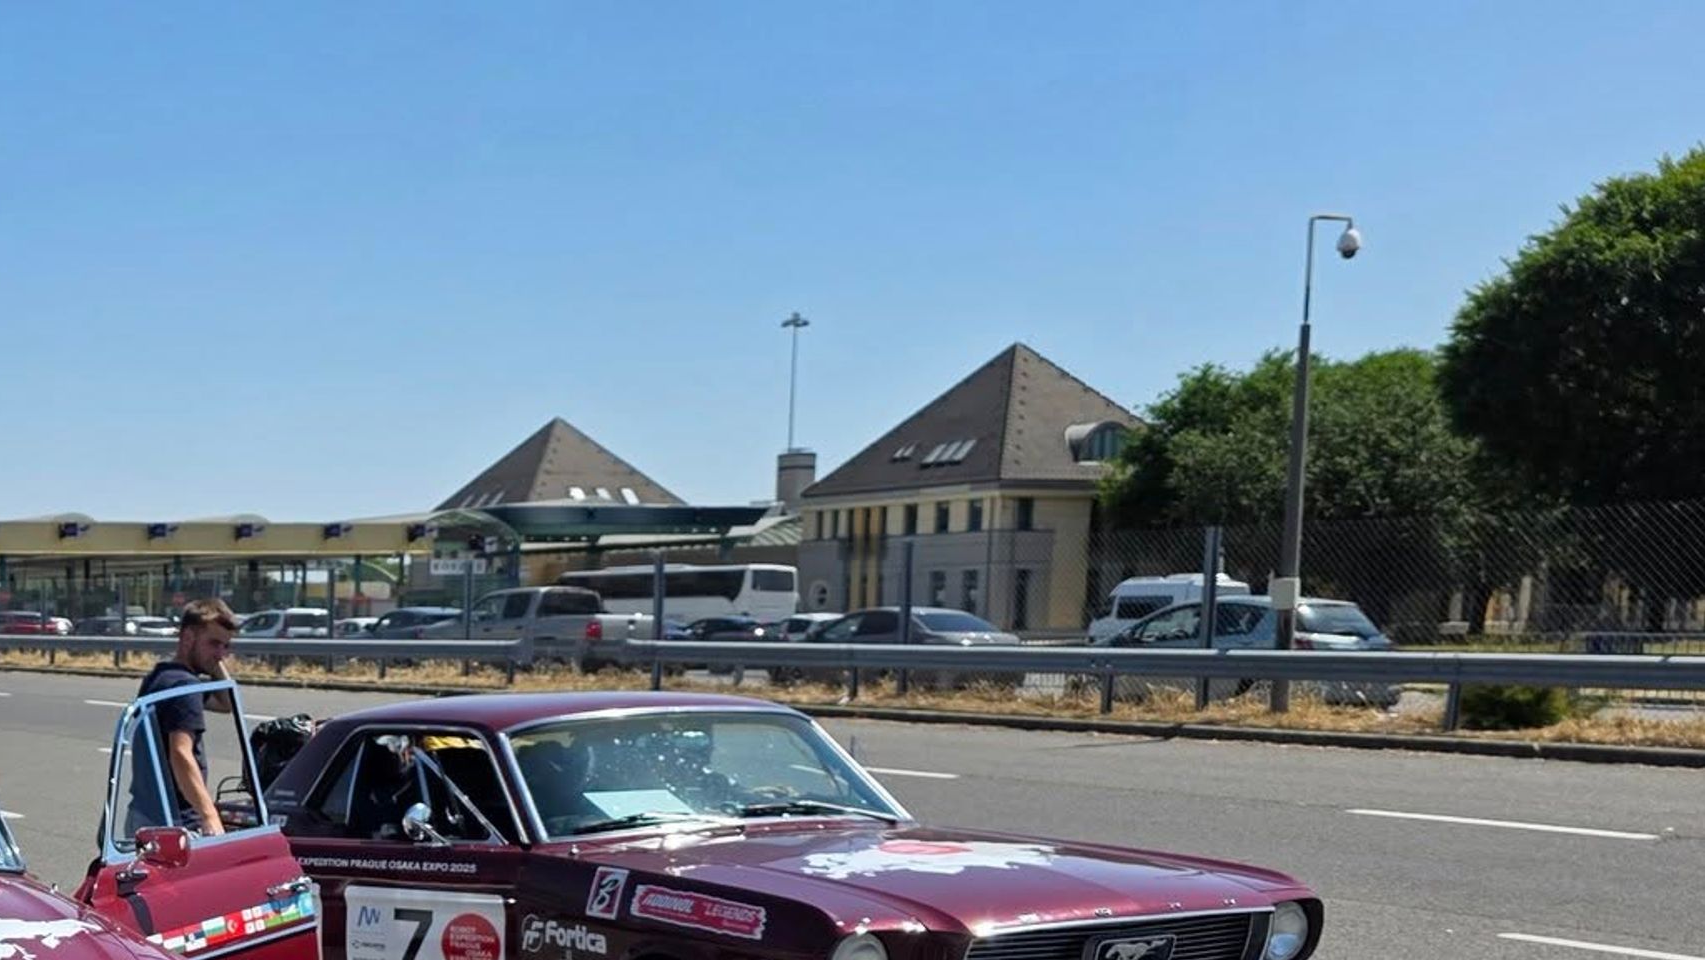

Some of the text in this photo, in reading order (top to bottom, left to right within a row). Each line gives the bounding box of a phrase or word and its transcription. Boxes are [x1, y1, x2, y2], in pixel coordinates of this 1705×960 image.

[350, 860, 387, 870] PRAGUE
[388, 861, 421, 870] OSAKA
[422, 862, 448, 872] EXPO
[449, 863, 477, 873] 2025
[545, 920, 608, 955] Fortica
